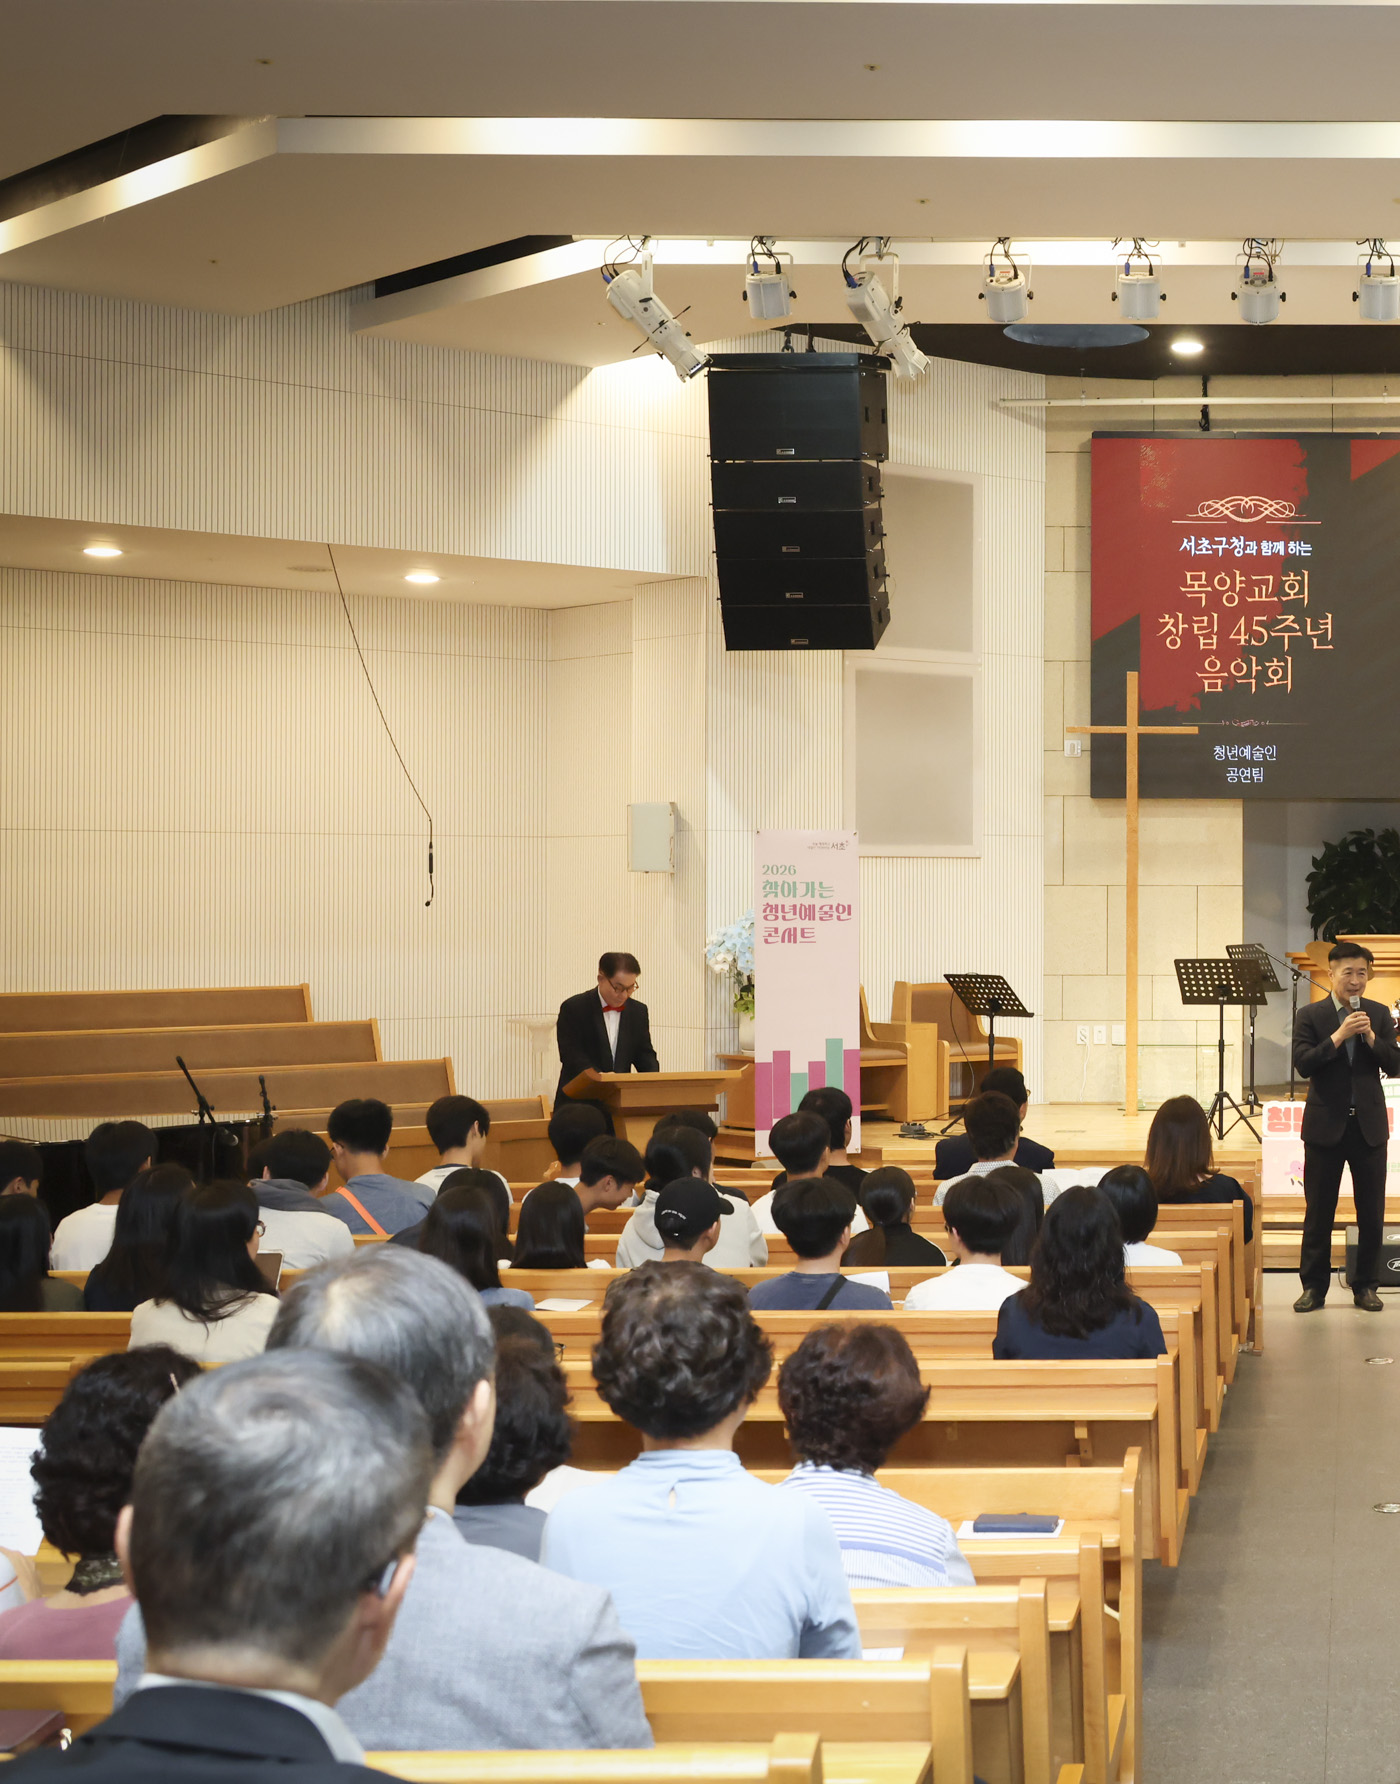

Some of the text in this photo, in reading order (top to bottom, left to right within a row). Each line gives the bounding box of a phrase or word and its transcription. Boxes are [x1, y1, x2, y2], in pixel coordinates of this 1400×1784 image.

[1179, 535, 1313, 557] 서초구청과 함께 하는
[1179, 569, 1310, 608] 목양교회
[1156, 612, 1335, 652] 창립 45주년
[1196, 655, 1293, 694] 음악회
[1213, 745, 1277, 761] 청년예술인
[1226, 767, 1264, 783] 공연팀
[831, 842, 846, 850] 서초
[762, 864, 797, 876] 2026
[762, 879, 835, 899] 찾아가는
[762, 902, 852, 922] 청년예술인
[762, 926, 817, 945] 콘서트
